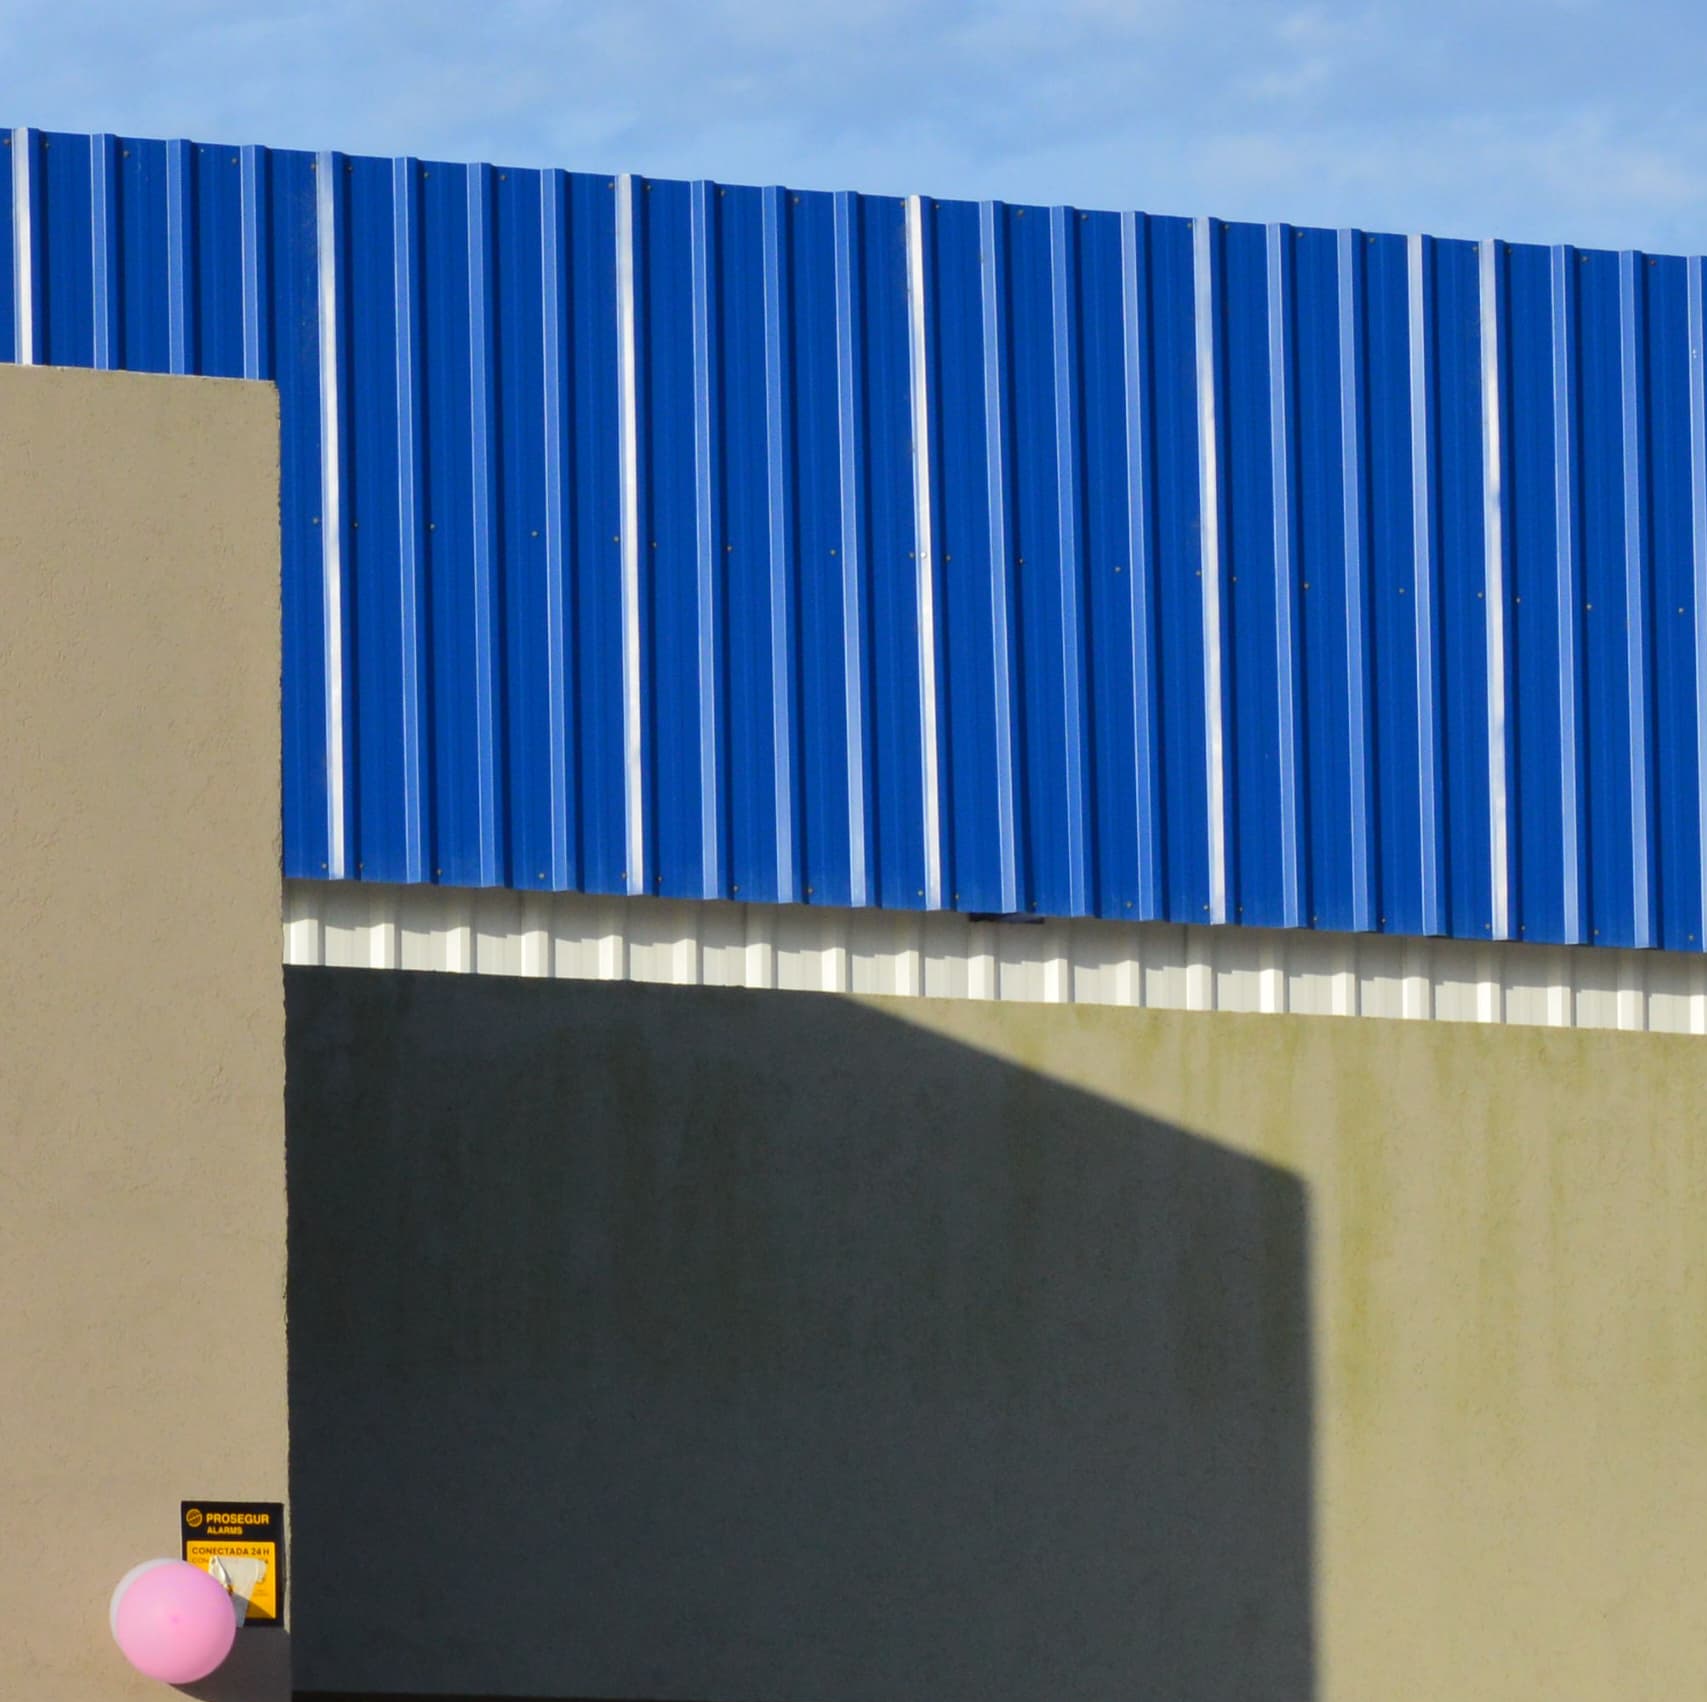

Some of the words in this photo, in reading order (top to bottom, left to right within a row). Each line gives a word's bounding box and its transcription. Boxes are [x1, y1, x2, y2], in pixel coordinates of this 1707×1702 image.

[206, 1513, 269, 1524] PROSEGUR
[207, 1526, 243, 1535] ALARMS
[191, 1546, 249, 1556] CONECTADA
